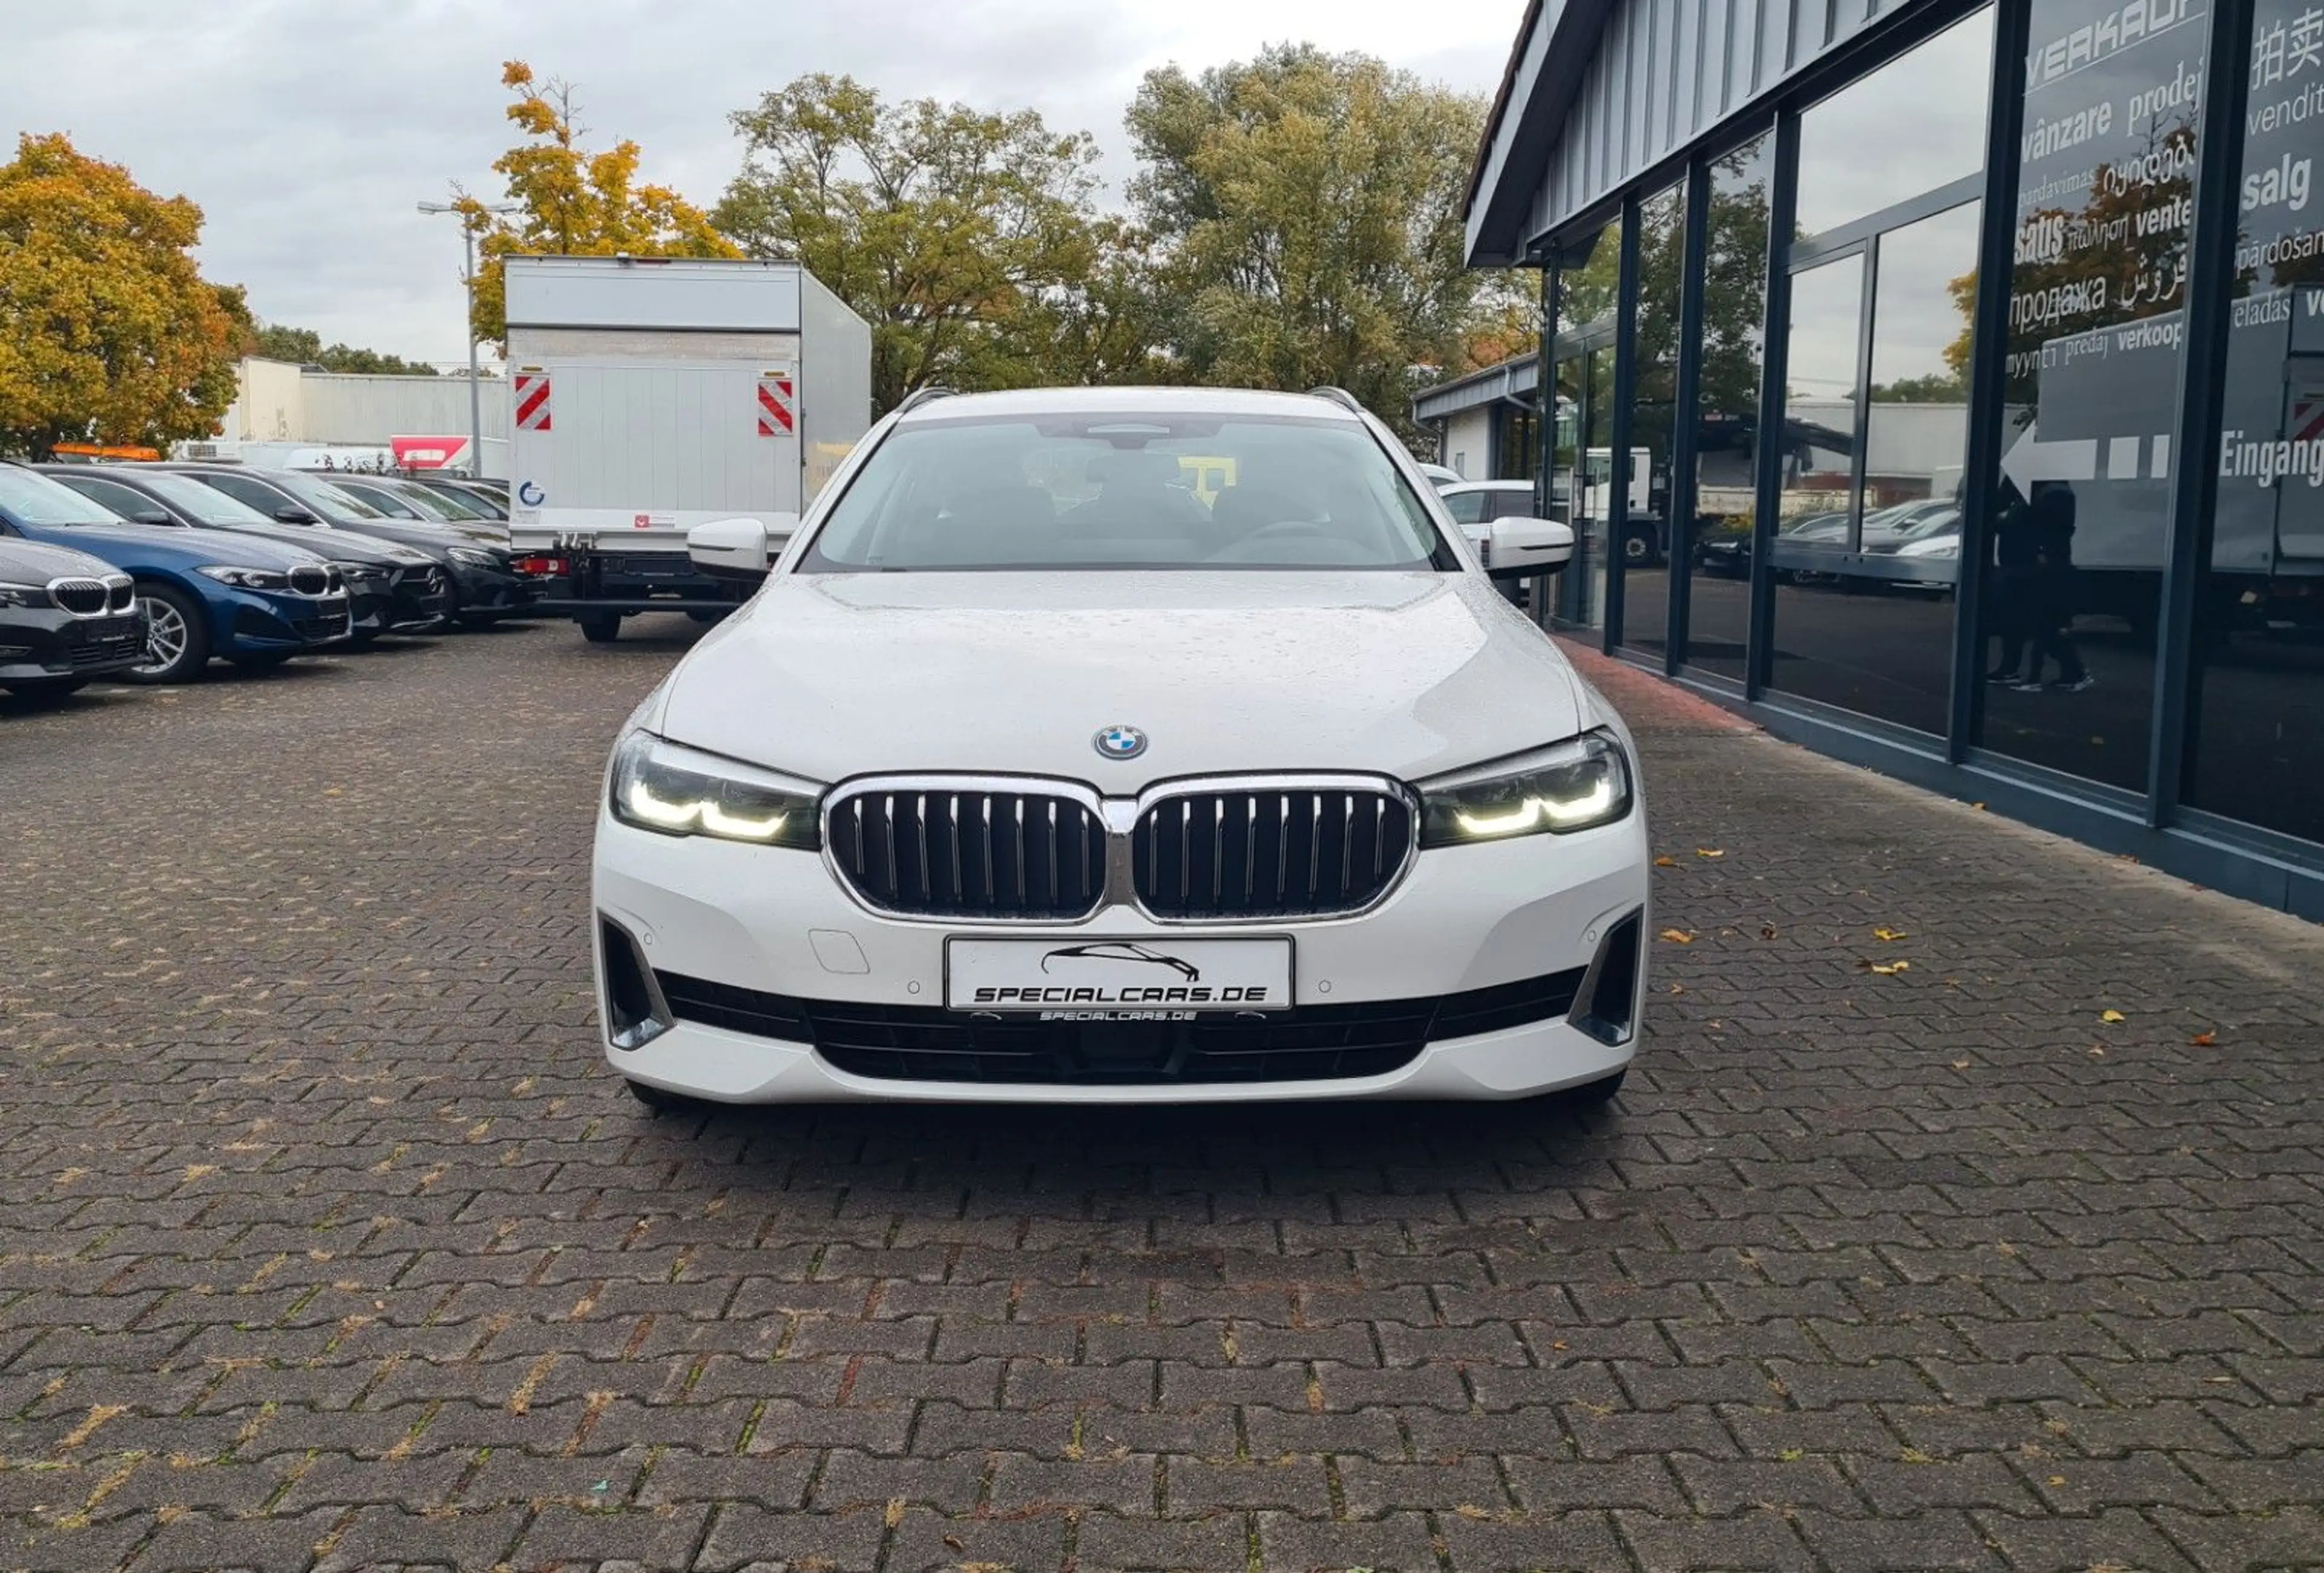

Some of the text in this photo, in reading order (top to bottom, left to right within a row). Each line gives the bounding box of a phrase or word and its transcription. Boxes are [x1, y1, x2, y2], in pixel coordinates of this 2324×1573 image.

[2252, 8, 2323, 91] 拍卖
[2022, 56, 2203, 162] vânzare prodej
[2248, 82, 2324, 136] vendit
[2242, 153, 2311, 211] salg
[2136, 196, 2190, 237] vente
[2009, 275, 2107, 335] продажа
[2234, 292, 2291, 327] eladás
[2065, 328, 2109, 366] predaj
[2219, 430, 2324, 488] Eingang
[974, 988, 1267, 1002] SPECIALCARS.DE
[1040, 1012, 1197, 1021] SPECIALCARS.DE
